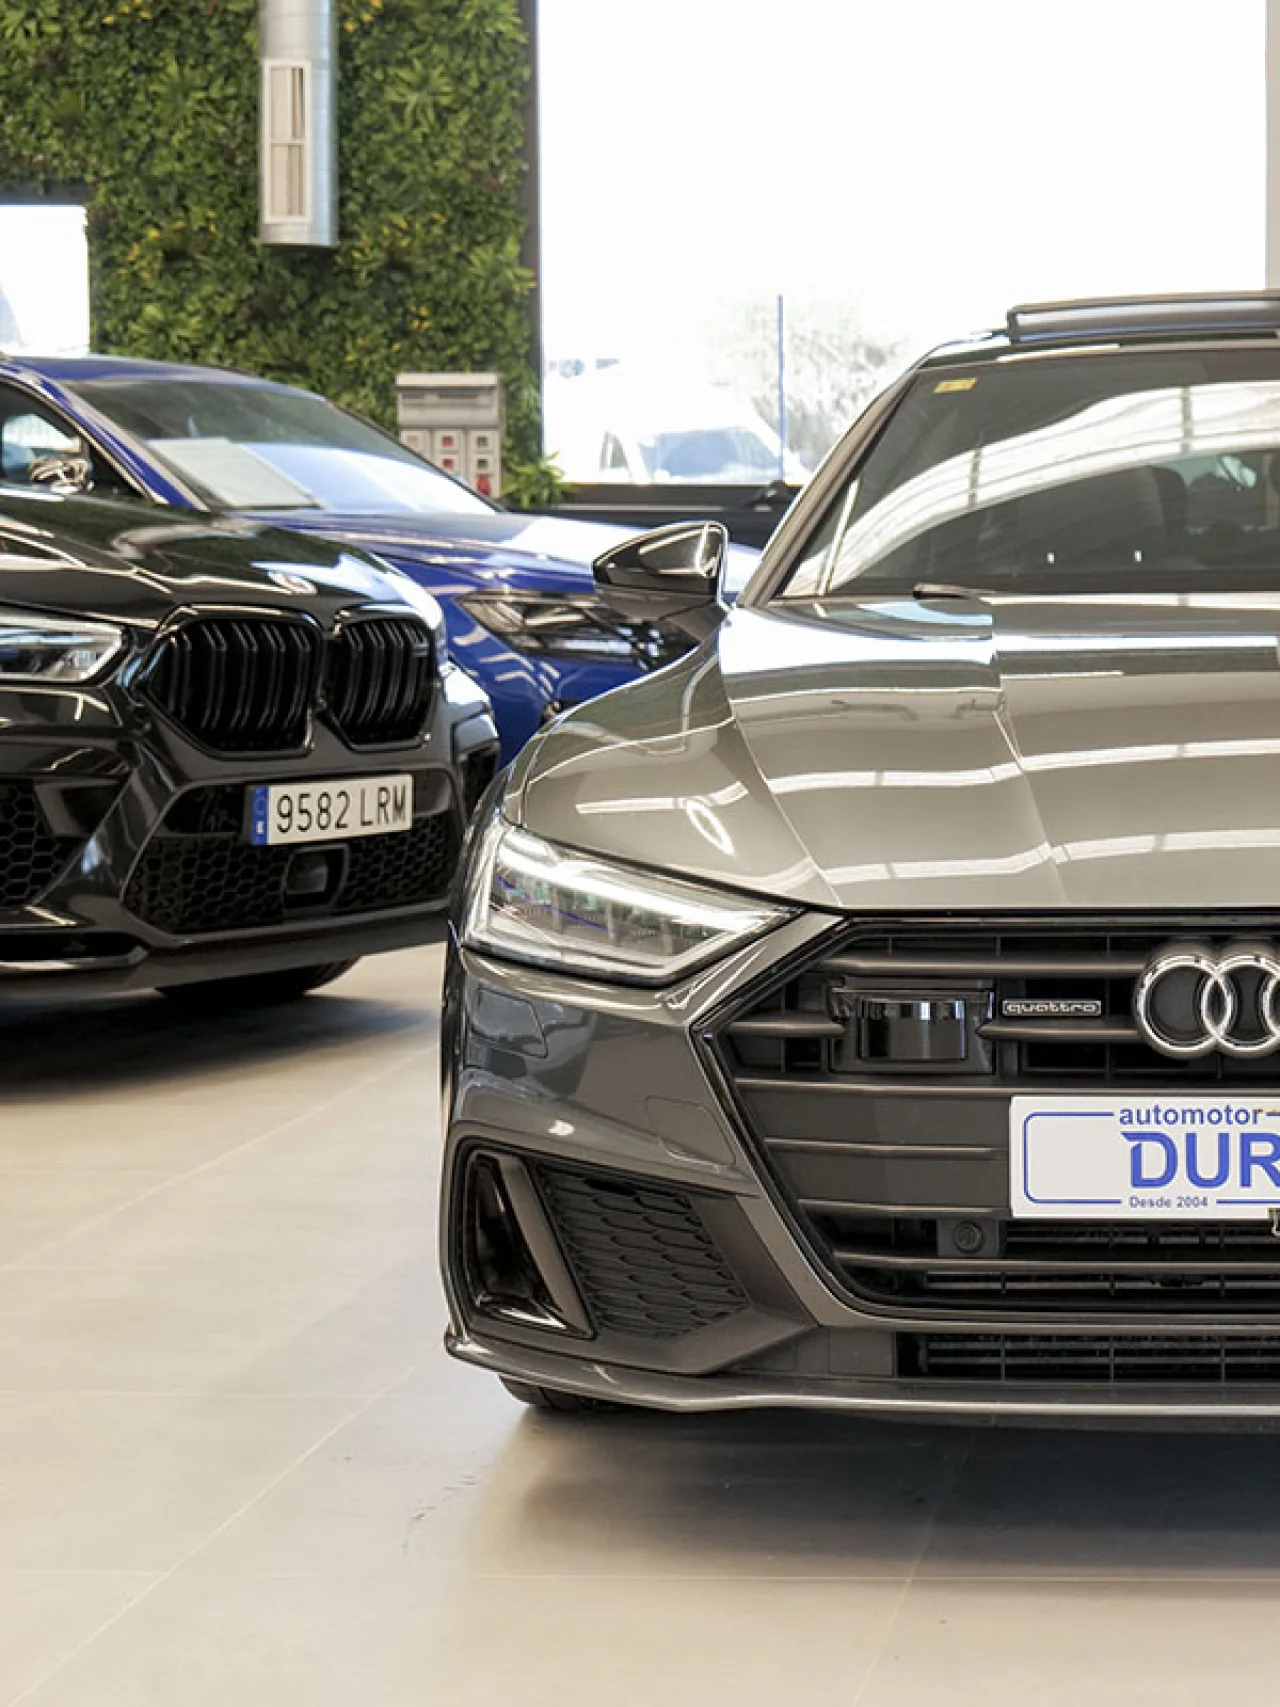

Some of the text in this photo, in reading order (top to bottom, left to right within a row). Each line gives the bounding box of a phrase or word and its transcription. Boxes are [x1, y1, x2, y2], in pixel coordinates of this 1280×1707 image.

[277, 784, 406, 834] 9582 LRM
[1006, 1001, 1096, 1014] quattro
[1118, 1105, 1264, 1126] automotor
[1129, 1196, 1209, 1208] Desde 2004
